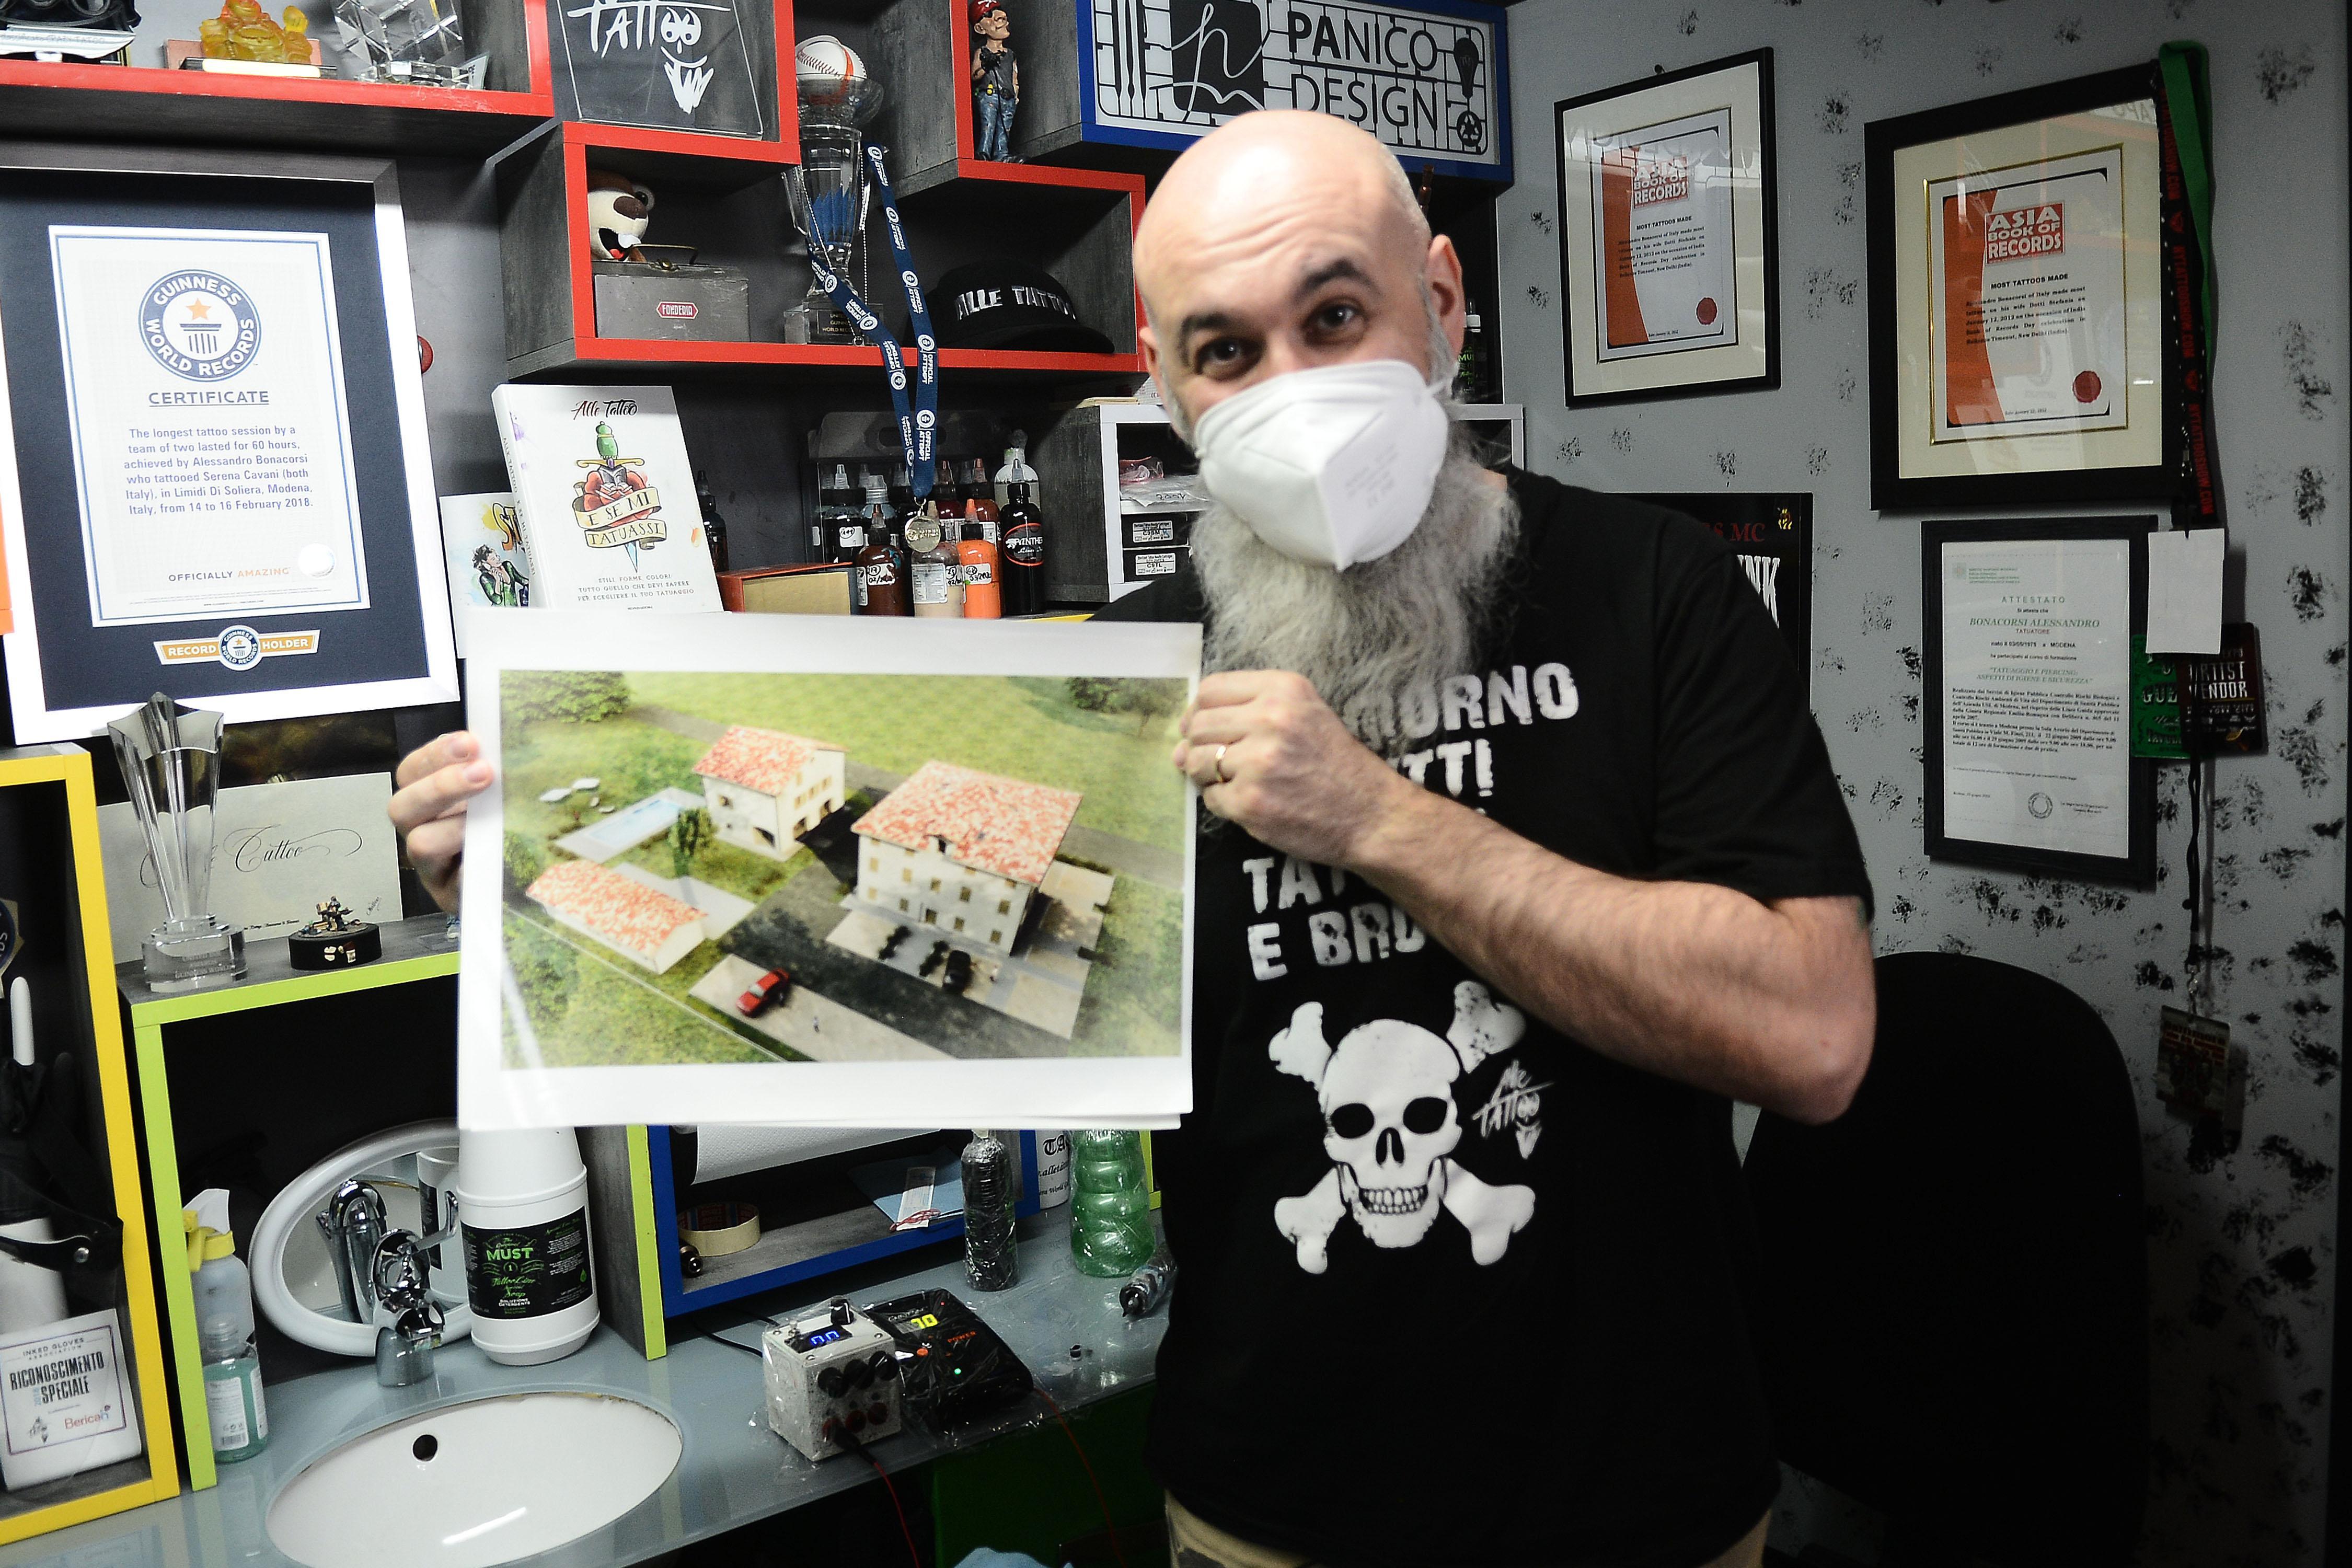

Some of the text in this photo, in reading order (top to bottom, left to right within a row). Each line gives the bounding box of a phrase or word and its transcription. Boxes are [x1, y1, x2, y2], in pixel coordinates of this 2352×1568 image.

[1288, 11, 1437, 71] PANICO
[1291, 74, 1437, 131] DESIGN
[1634, 177, 1666, 190] BOOK
[1634, 182, 1687, 204] RECORDS
[1652, 218, 1676, 228] TATTOOS
[1988, 206, 2060, 232] ASIA
[1988, 222, 2060, 241] BOOK OF
[1988, 233, 2061, 259] RECORDS
[153, 276, 242, 306] GUINNESS
[1991, 273, 2068, 290] MOST TATTOOS MADE
[954, 288, 1002, 320] ALLE
[146, 318, 255, 376] WORLD RECORDS
[148, 391, 269, 405] CERTIFICATE
[571, 399, 637, 420] Alle Tattoo
[129, 429, 149, 439] The
[153, 428, 193, 440] longest
[197, 428, 227, 437] tattoo
[232, 426, 271, 436] session
[274, 425, 286, 436] by
[128, 440, 300, 454] team of two lasted for 60 hours,
[124, 453, 308, 469] achieved by Alessandro Bonacorsi
[126, 469, 308, 484] who tattooed Serena Cavani (both
[125, 484, 313, 500] Italy), in Limidi Di Soliera, Modena,
[129, 498, 313, 516] Italy, from 14 to 16 February 2018.
[588, 491, 651, 526] E SE MI
[588, 522, 664, 545] TATUASSI
[1014, 537, 1043, 546] PANTHE
[1730, 523, 1766, 543] MC
[168, 568, 289, 582] OFFICIALLY AMAZING
[656, 589, 694, 597] TATUAGGIO
[1737, 554, 1780, 629] NK
[1969, 617, 2101, 628] BONACORSI ALESSANDRO
[224, 630, 253, 642] GUINNESS
[168, 638, 308, 656] RECORD HOLDER
[222, 643, 258, 664] WORLD RECORDS
[2143, 682, 2178, 704] GUE
[1242, 857, 1346, 914] TAT
[1247, 903, 1426, 981] E BRU
[486, 1248, 534, 1261] MUST
[23, 1338, 84, 1356] INKED GLOVES
[10, 1351, 105, 1390] RICONOSCIMENTO
[41, 1376, 89, 1404] SPECIALE
